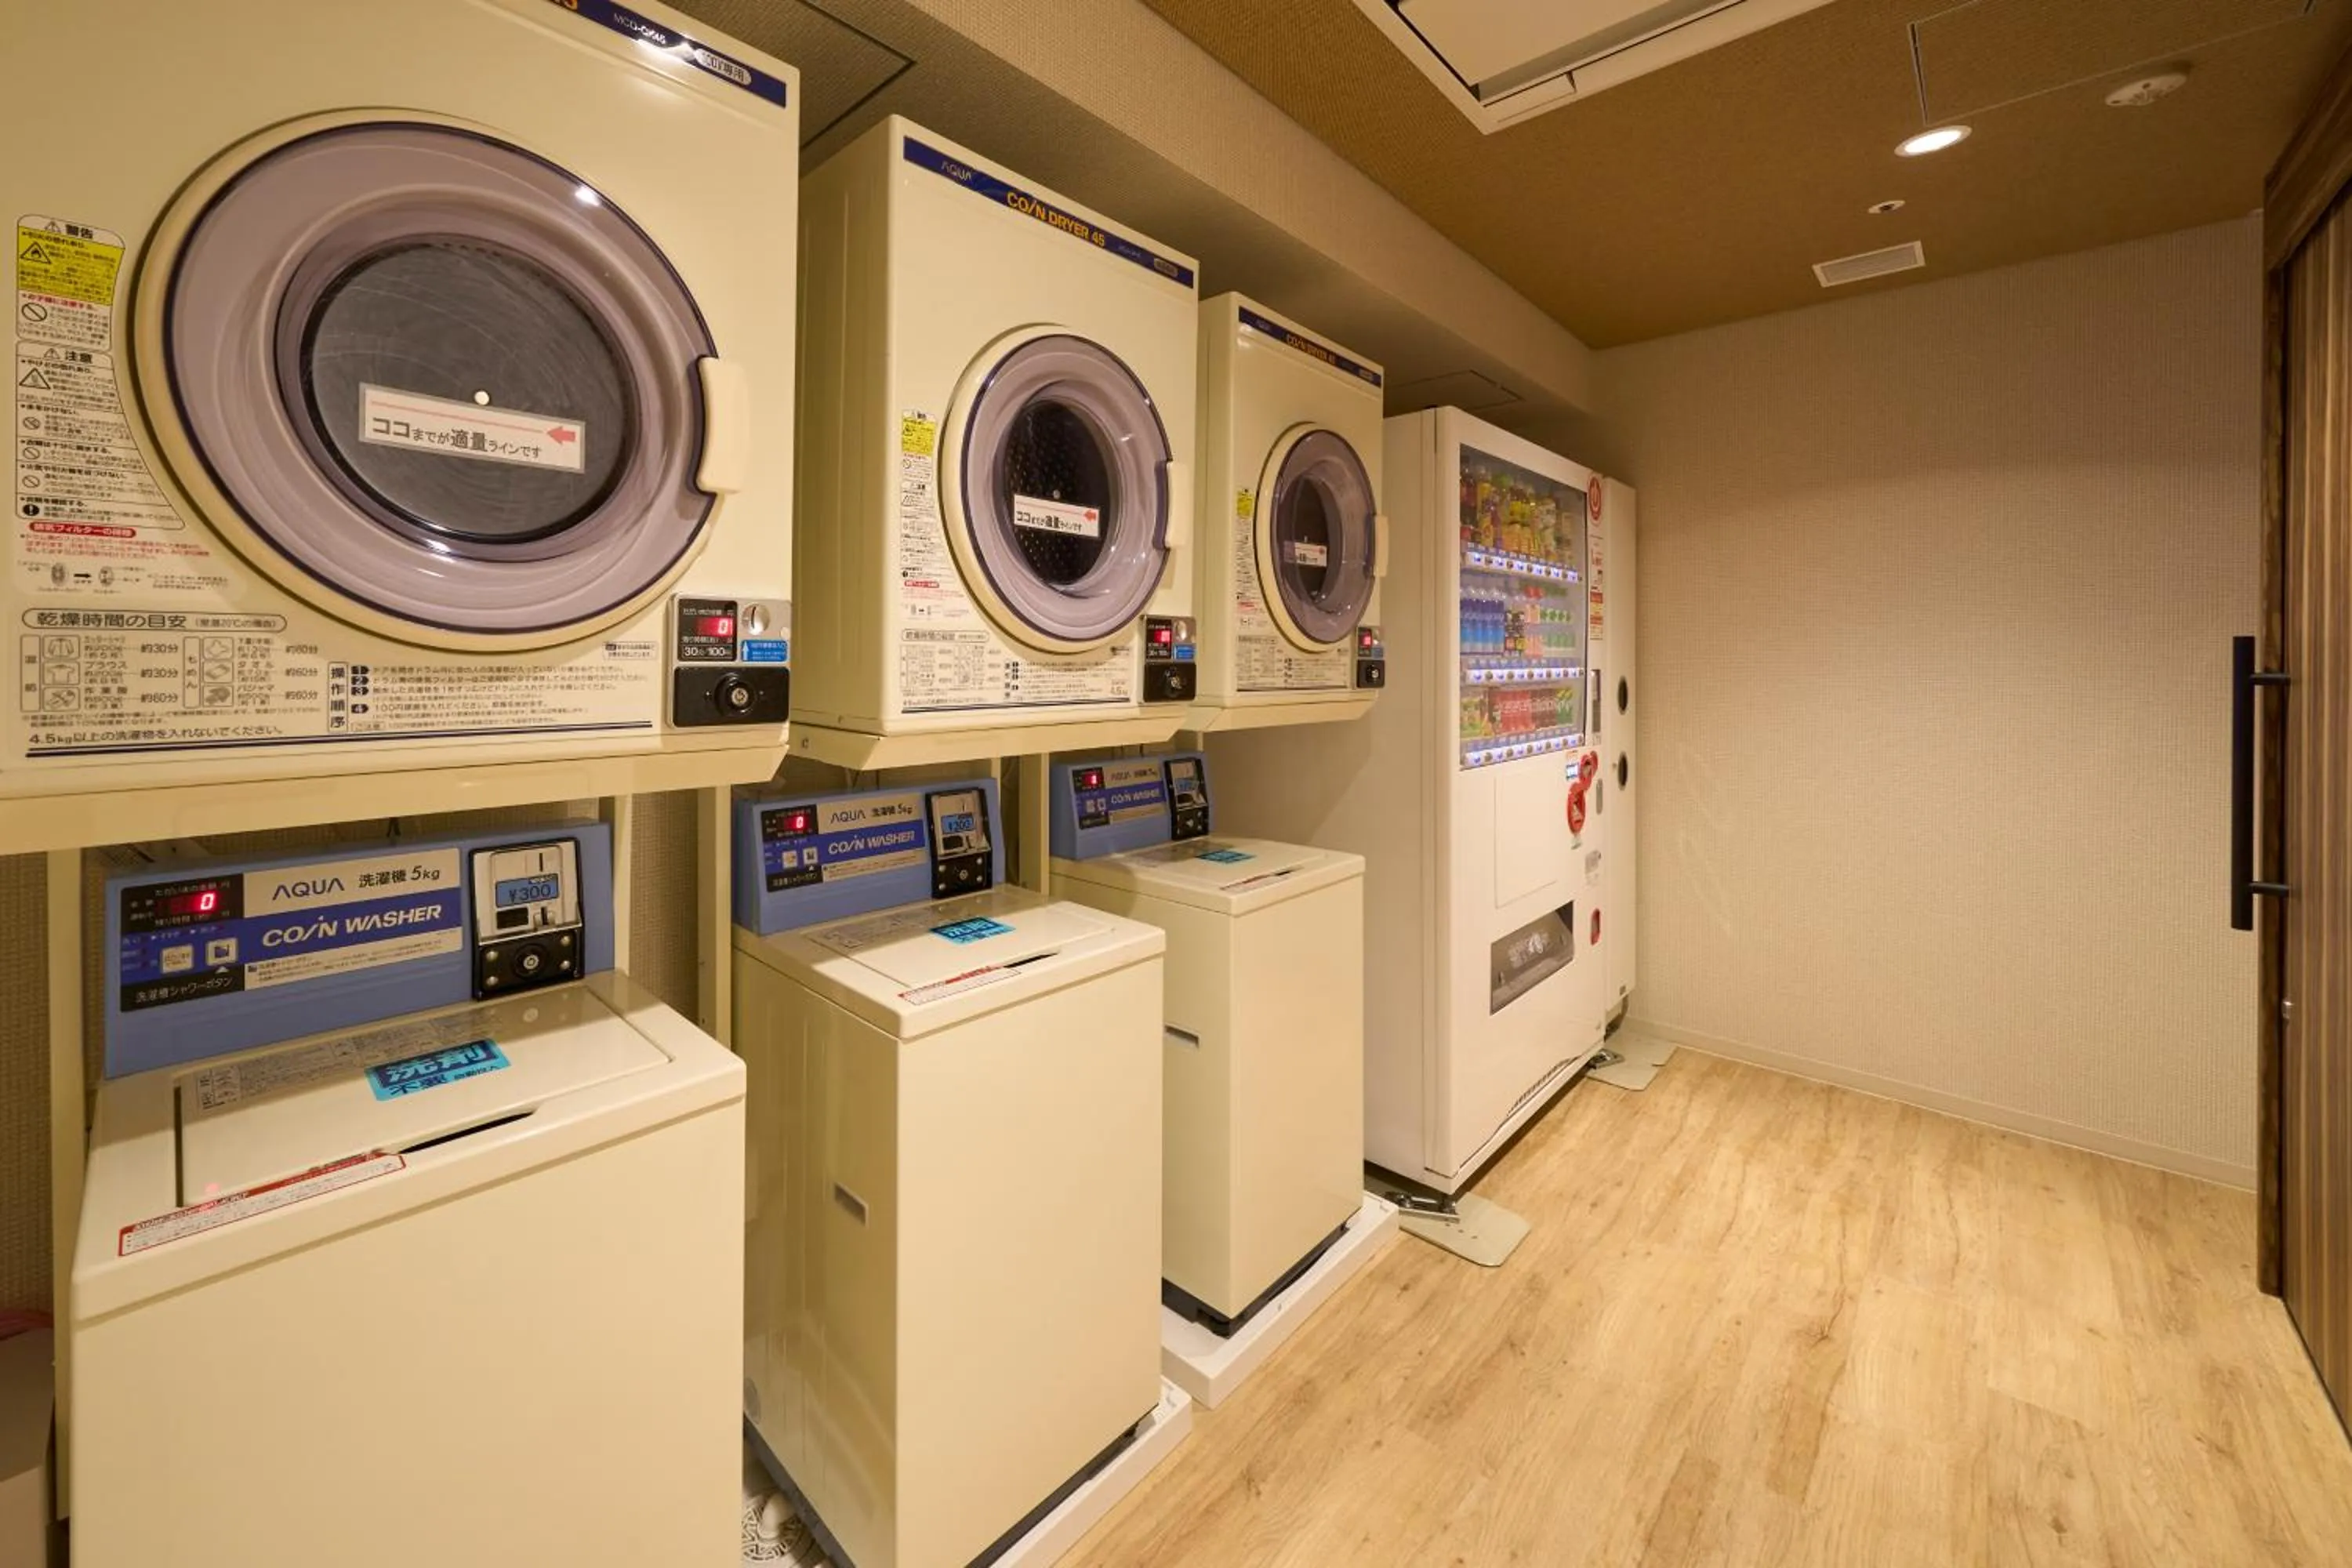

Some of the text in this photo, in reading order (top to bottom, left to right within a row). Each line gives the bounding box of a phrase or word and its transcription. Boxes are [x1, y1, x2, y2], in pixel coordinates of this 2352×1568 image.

[942, 162, 971, 181] AQUA
[1048, 212, 1090, 239] DRYER
[1092, 233, 1105, 246] 45
[372, 417, 542, 458] ココまでが適量ラインです
[38, 612, 187, 627] 乾燥時間の目安
[717, 618, 728, 634] 0
[140, 644, 179, 653] 約30分
[330, 666, 346, 729] 操作順序
[796, 816, 804, 829] 0
[829, 809, 866, 824] AQUA
[867, 830, 915, 848] WASHER
[359, 865, 441, 888] 洗濯機 5kg
[272, 877, 345, 901] AQUA
[509, 884, 552, 902] ¥300
[200, 893, 216, 910] 0
[346, 904, 441, 933] WASHER
[387, 1044, 487, 1082] 洗剤
